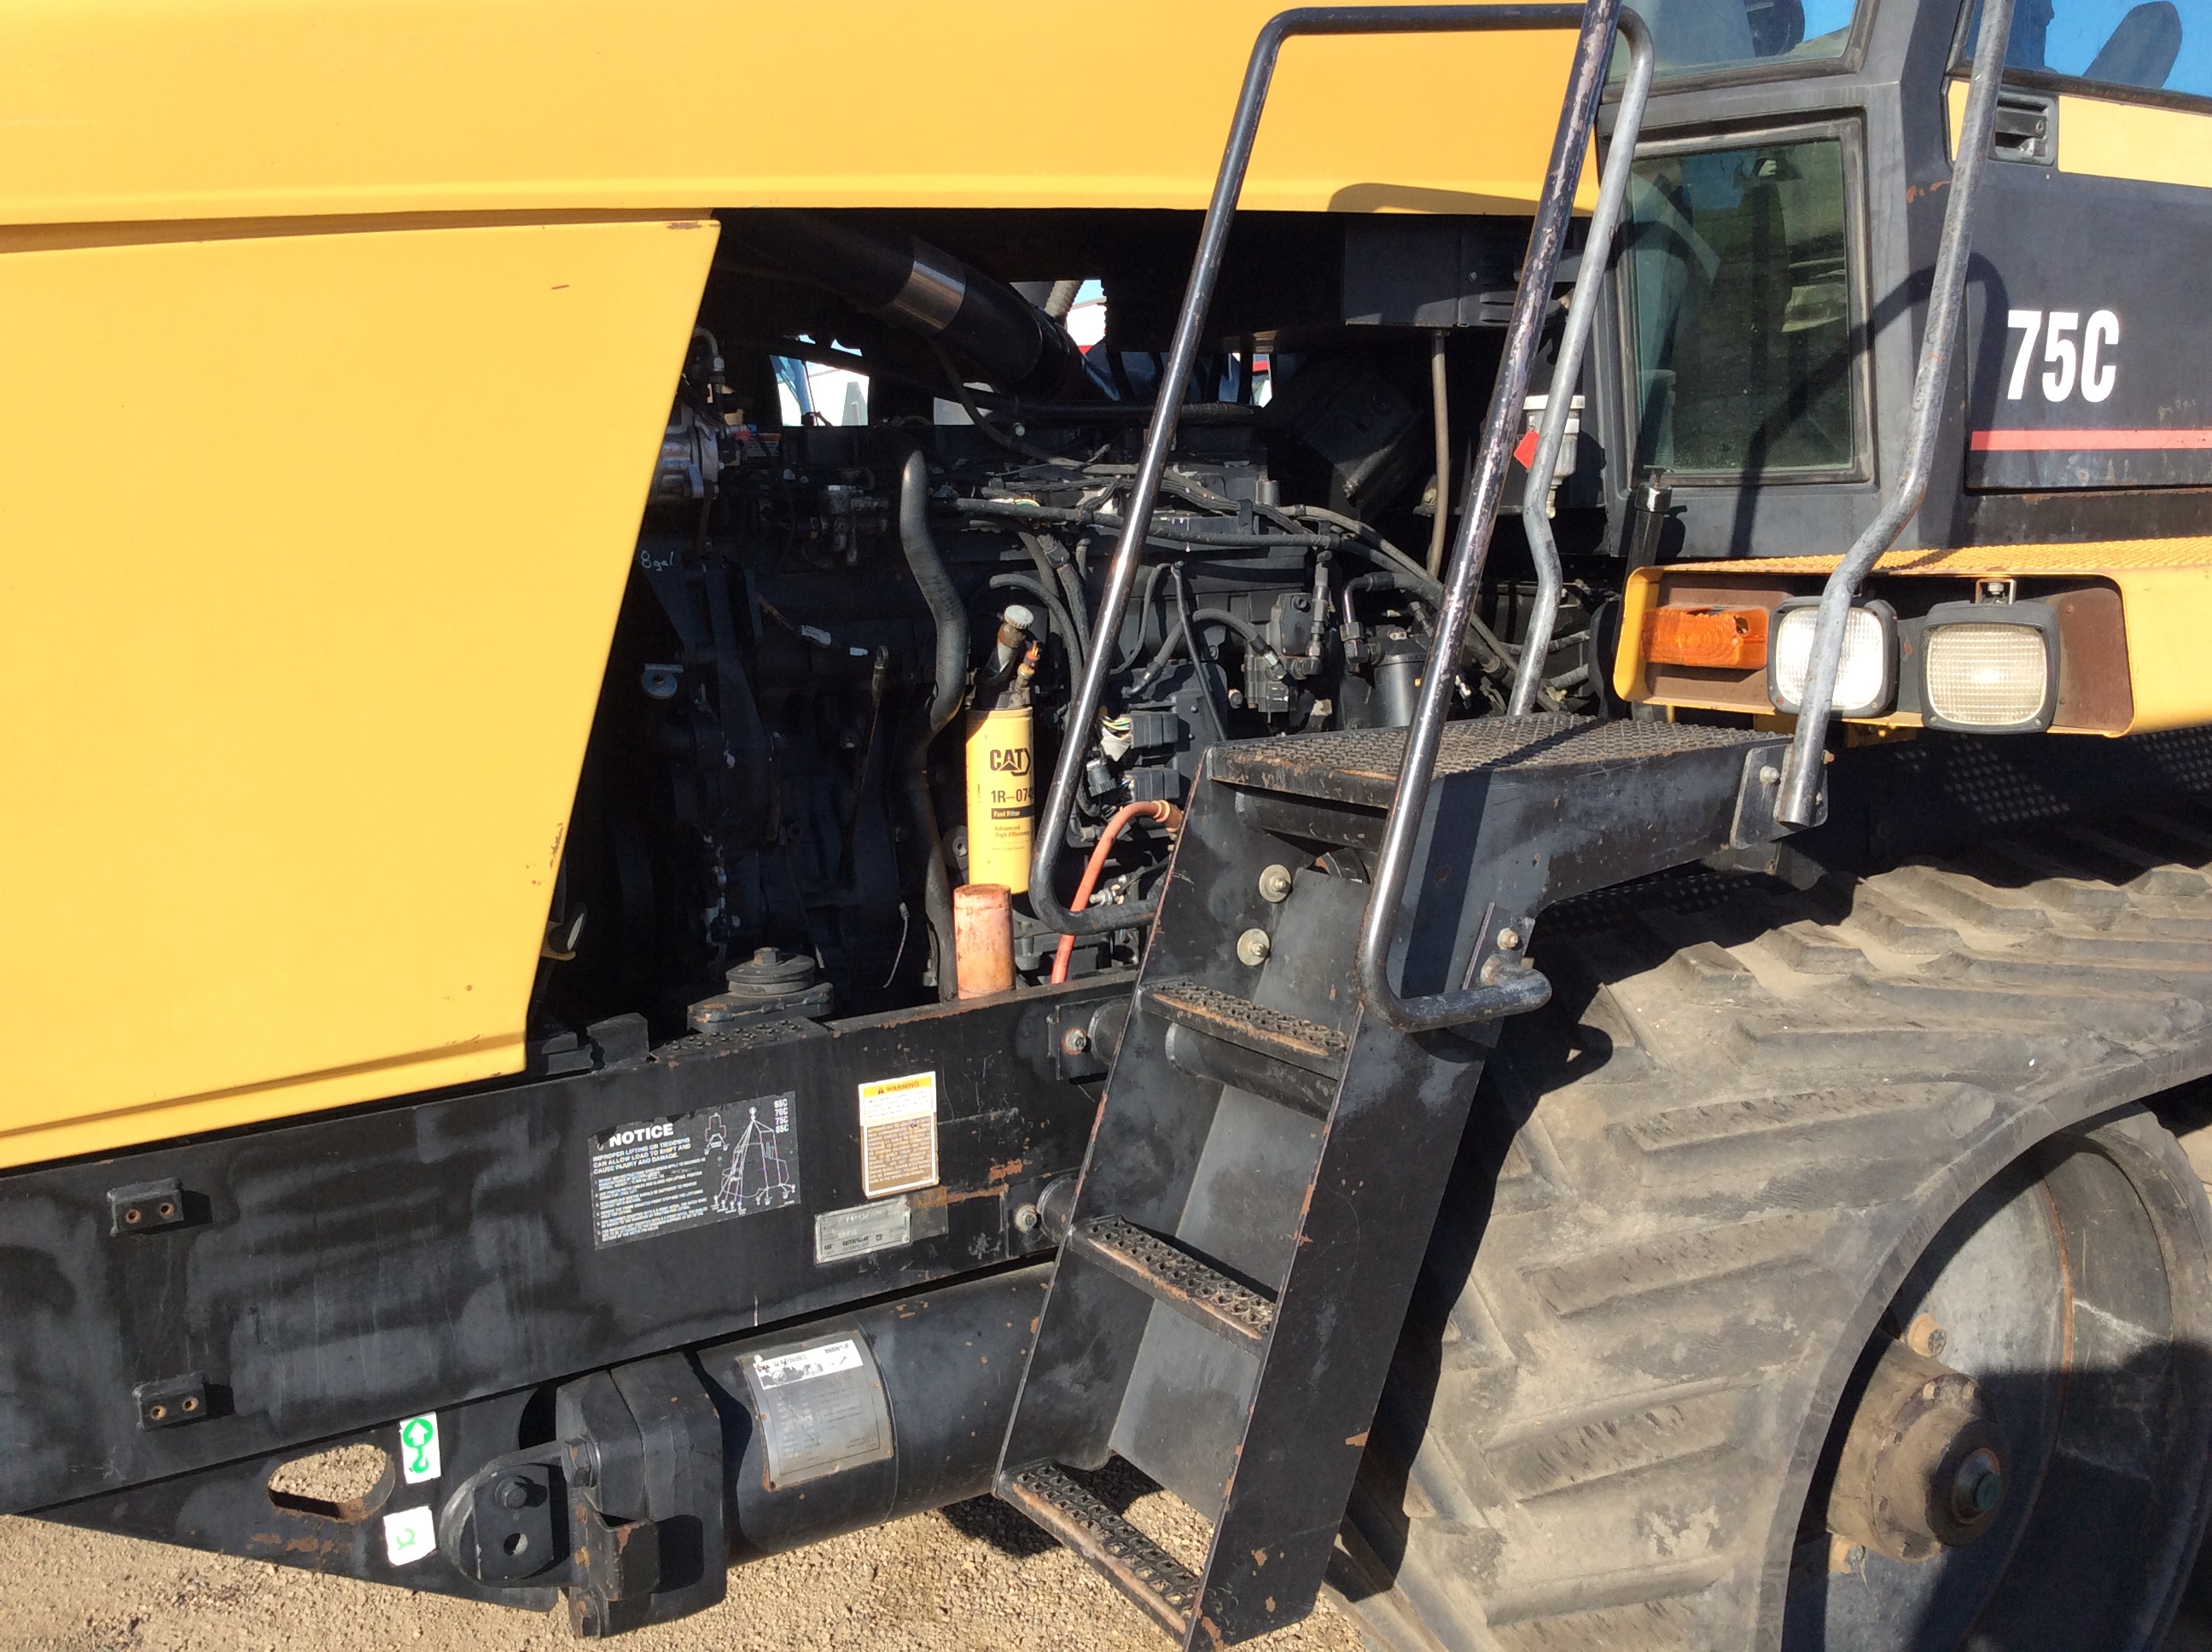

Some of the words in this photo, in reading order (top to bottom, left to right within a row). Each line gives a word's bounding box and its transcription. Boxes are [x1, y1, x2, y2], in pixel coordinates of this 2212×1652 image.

[2007, 310, 2119, 403] 75C
[989, 747, 1024, 772] CAT
[887, 1081, 920, 1091] WARNING
[774, 1107, 789, 1117] 70C
[774, 1115, 789, 1126] 75C
[608, 1123, 674, 1148] NOTICE
[592, 1150, 625, 1162] IMPROPER
[626, 1145, 649, 1155] LIFTING
[649, 1143, 659, 1151] OR
[660, 1137, 690, 1149] TIEDOWNS
[608, 1156, 631, 1166] ALLOW
[632, 1152, 649, 1160] LOAD
[660, 1146, 677, 1155] SHIFT
[678, 1143, 691, 1151] AND
[593, 1166, 614, 1175] CAUSE
[615, 1160, 637, 1170] INJURY
[771, 1353, 807, 1367] WARNING
